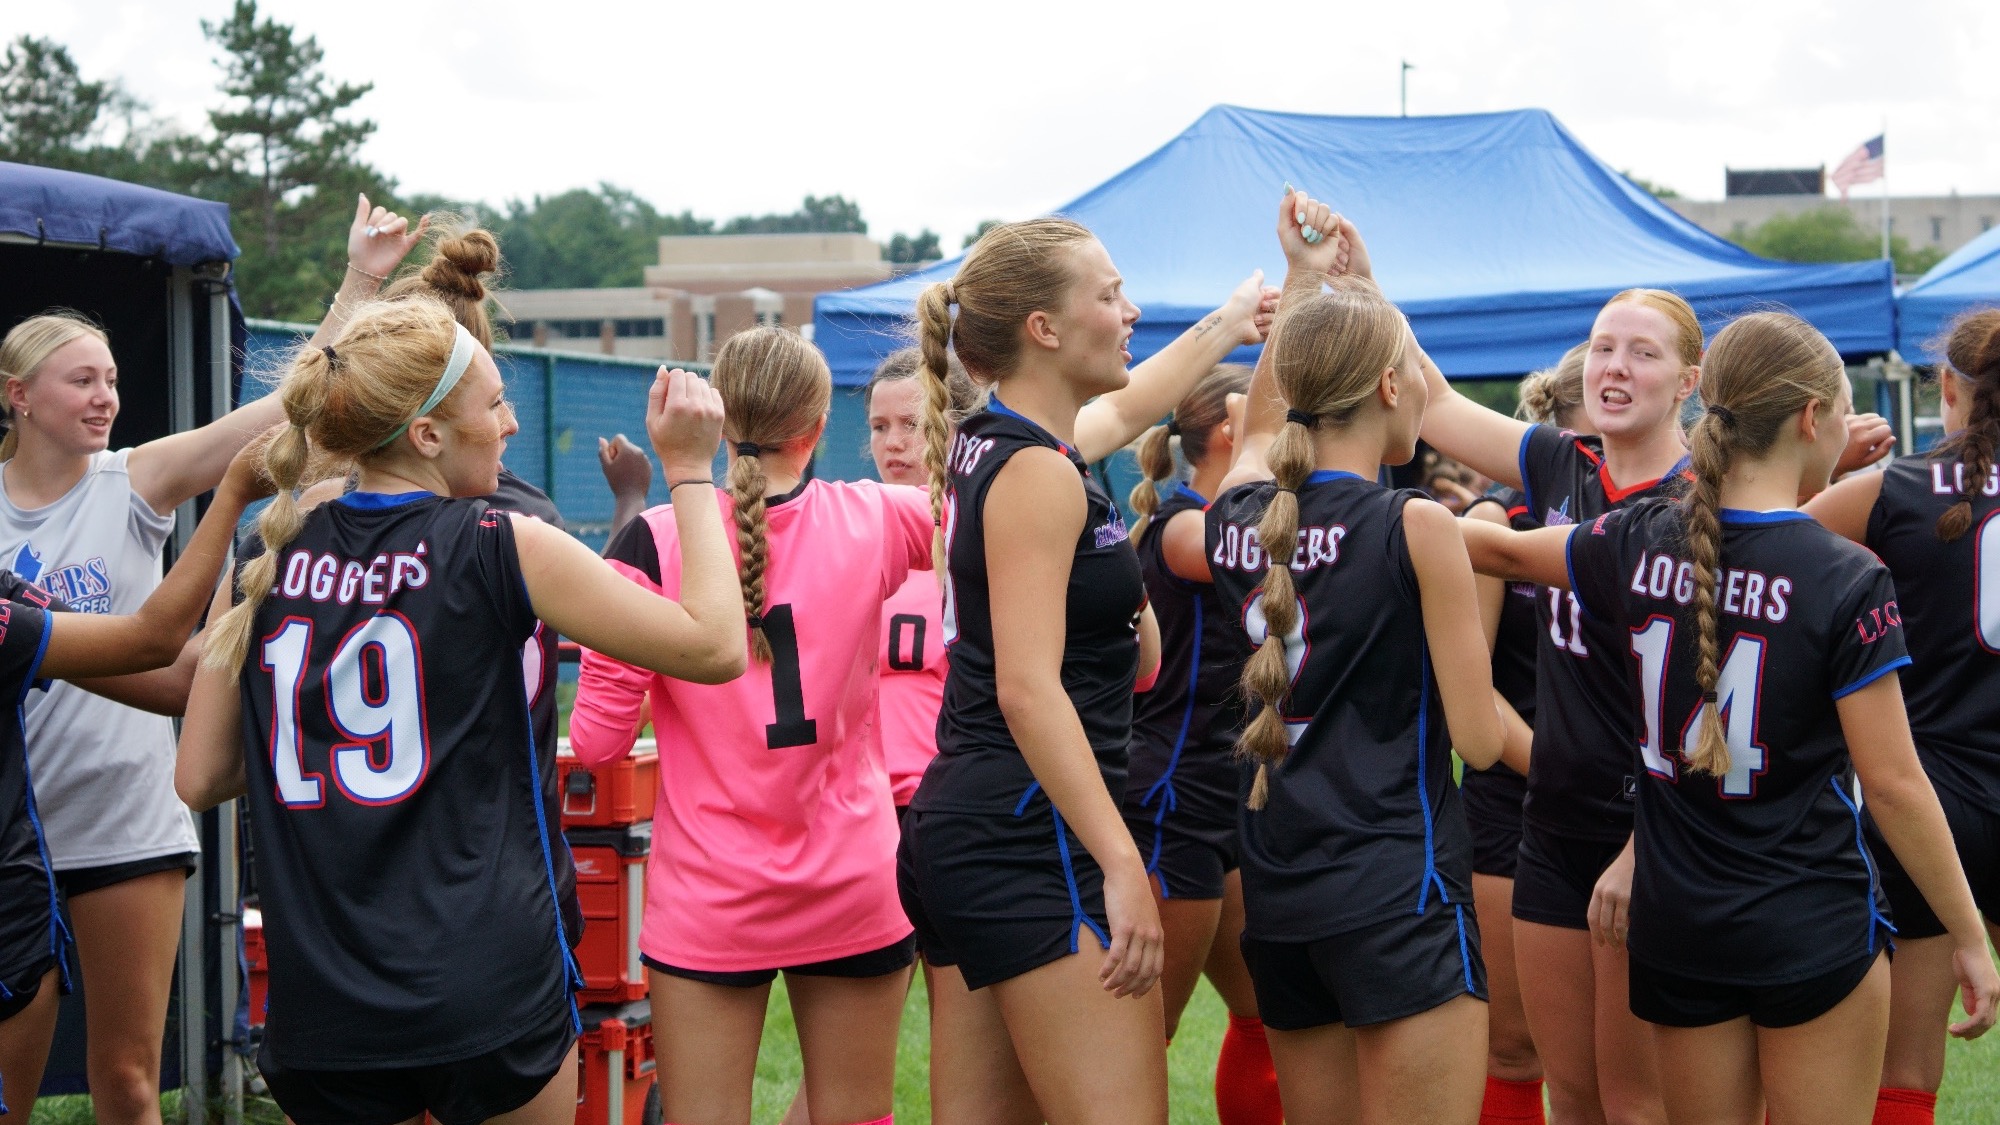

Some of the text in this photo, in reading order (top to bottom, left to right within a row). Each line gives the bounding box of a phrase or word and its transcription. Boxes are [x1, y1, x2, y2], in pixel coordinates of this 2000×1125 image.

[270, 540, 429, 605] OGGERS
[1213, 523, 1347, 573] LOGERS
[888, 613, 927, 671] 0
[1548, 586, 1589, 658] 11
[259, 608, 431, 810] 19
[762, 603, 818, 750] 1
[1629, 613, 1769, 800] 14
